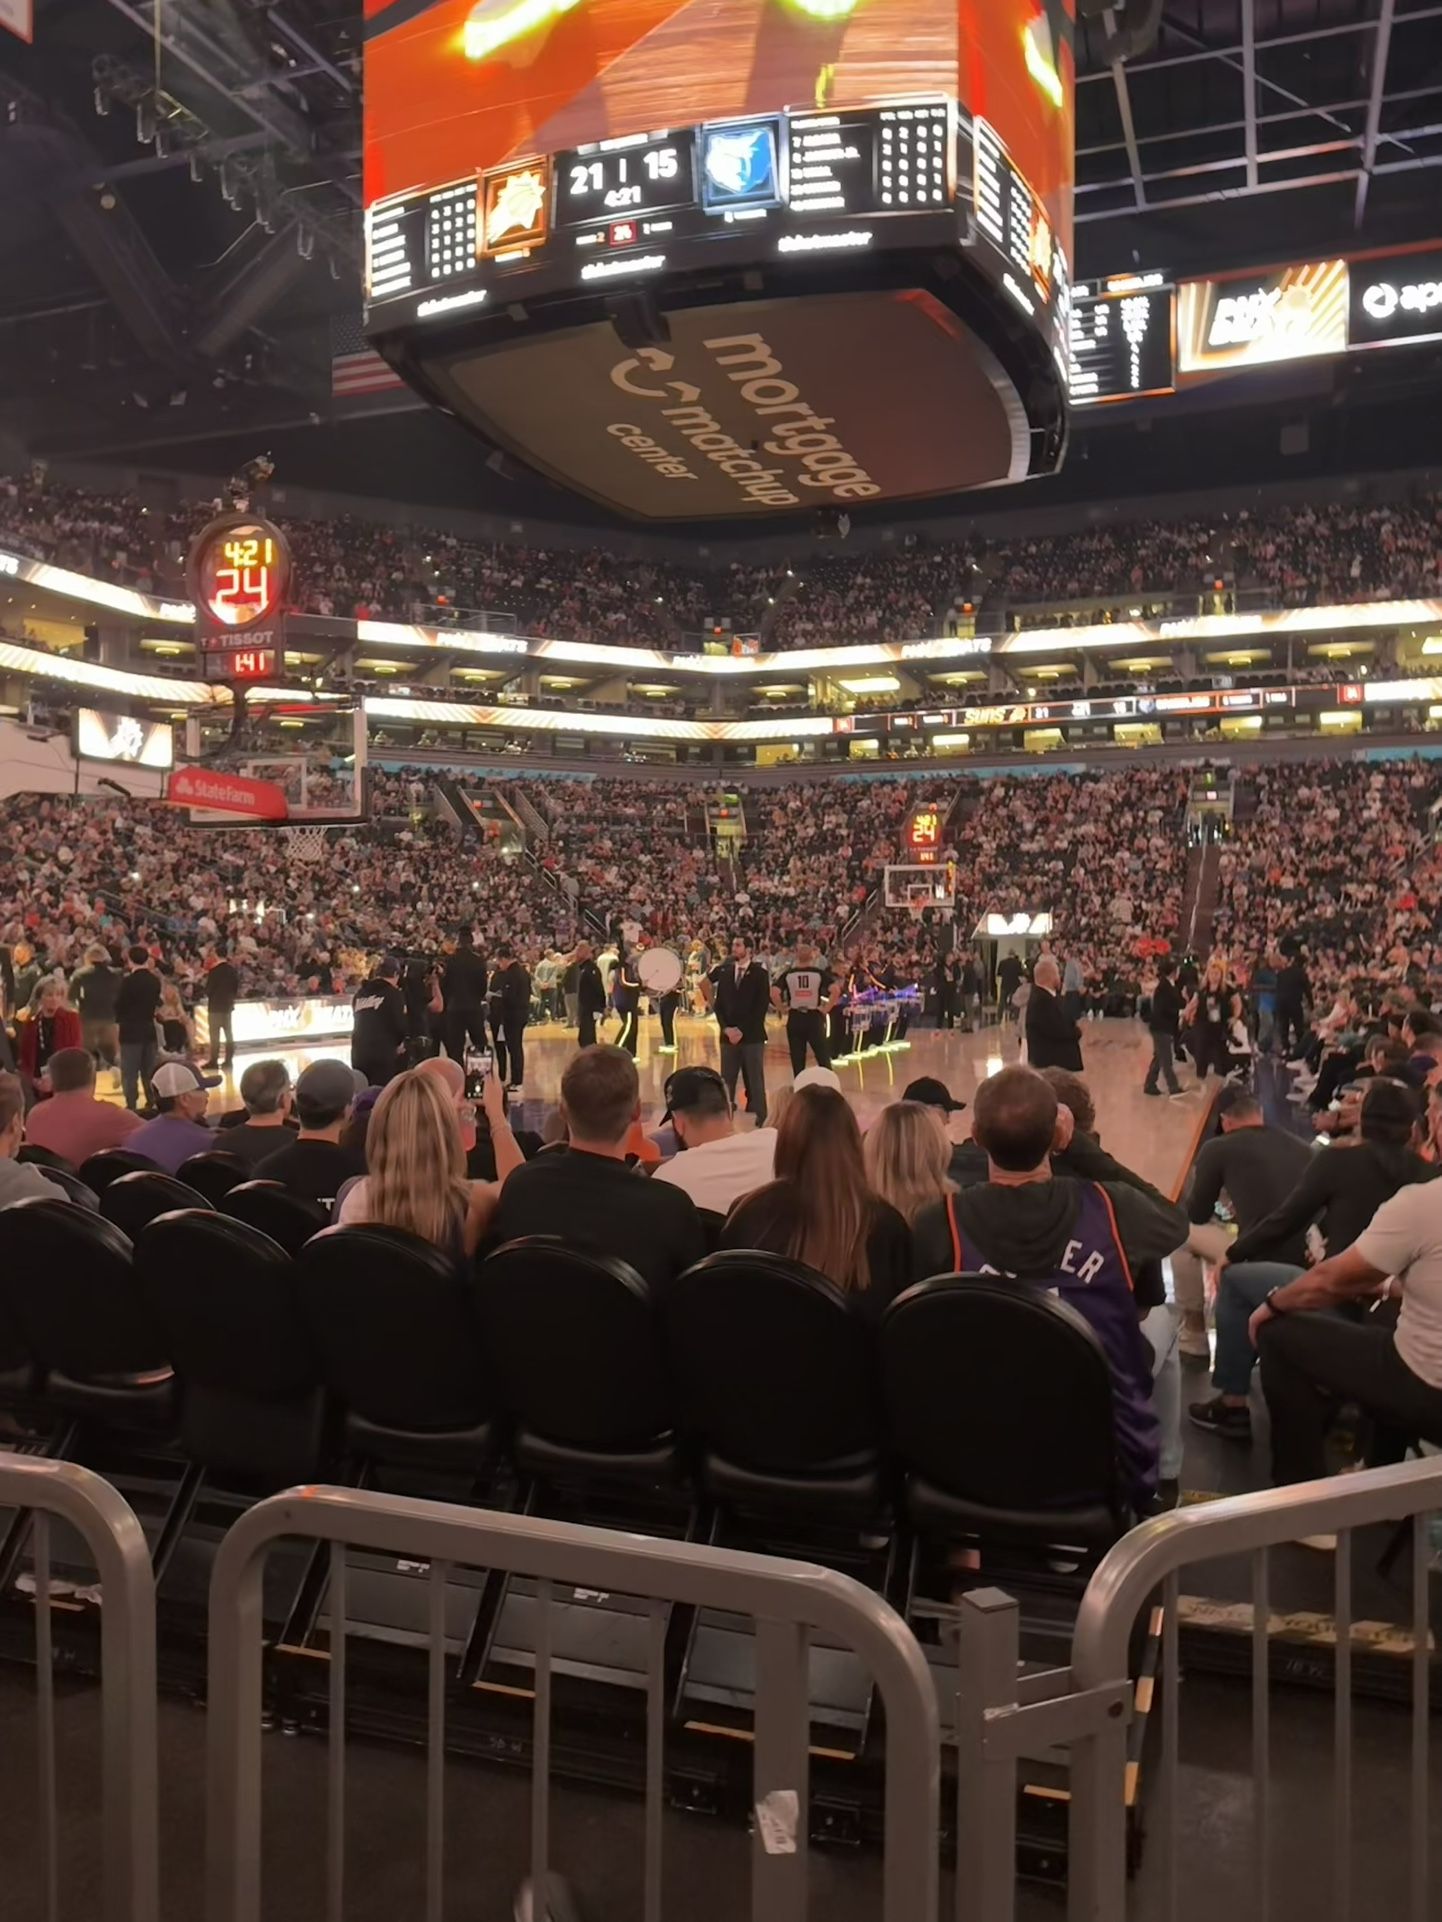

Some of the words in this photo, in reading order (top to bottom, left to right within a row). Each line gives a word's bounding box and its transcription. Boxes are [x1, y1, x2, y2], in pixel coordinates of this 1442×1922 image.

[570, 162, 603, 194] 21
[643, 149, 678, 179] 15
[702, 333, 881, 497] mortgage
[606, 423, 698, 480] center
[661, 406, 799, 505] matchup
[220, 630, 273, 646] TISSOT
[798, 975, 809, 989] 10
[1059, 1239, 1105, 1284] ER
